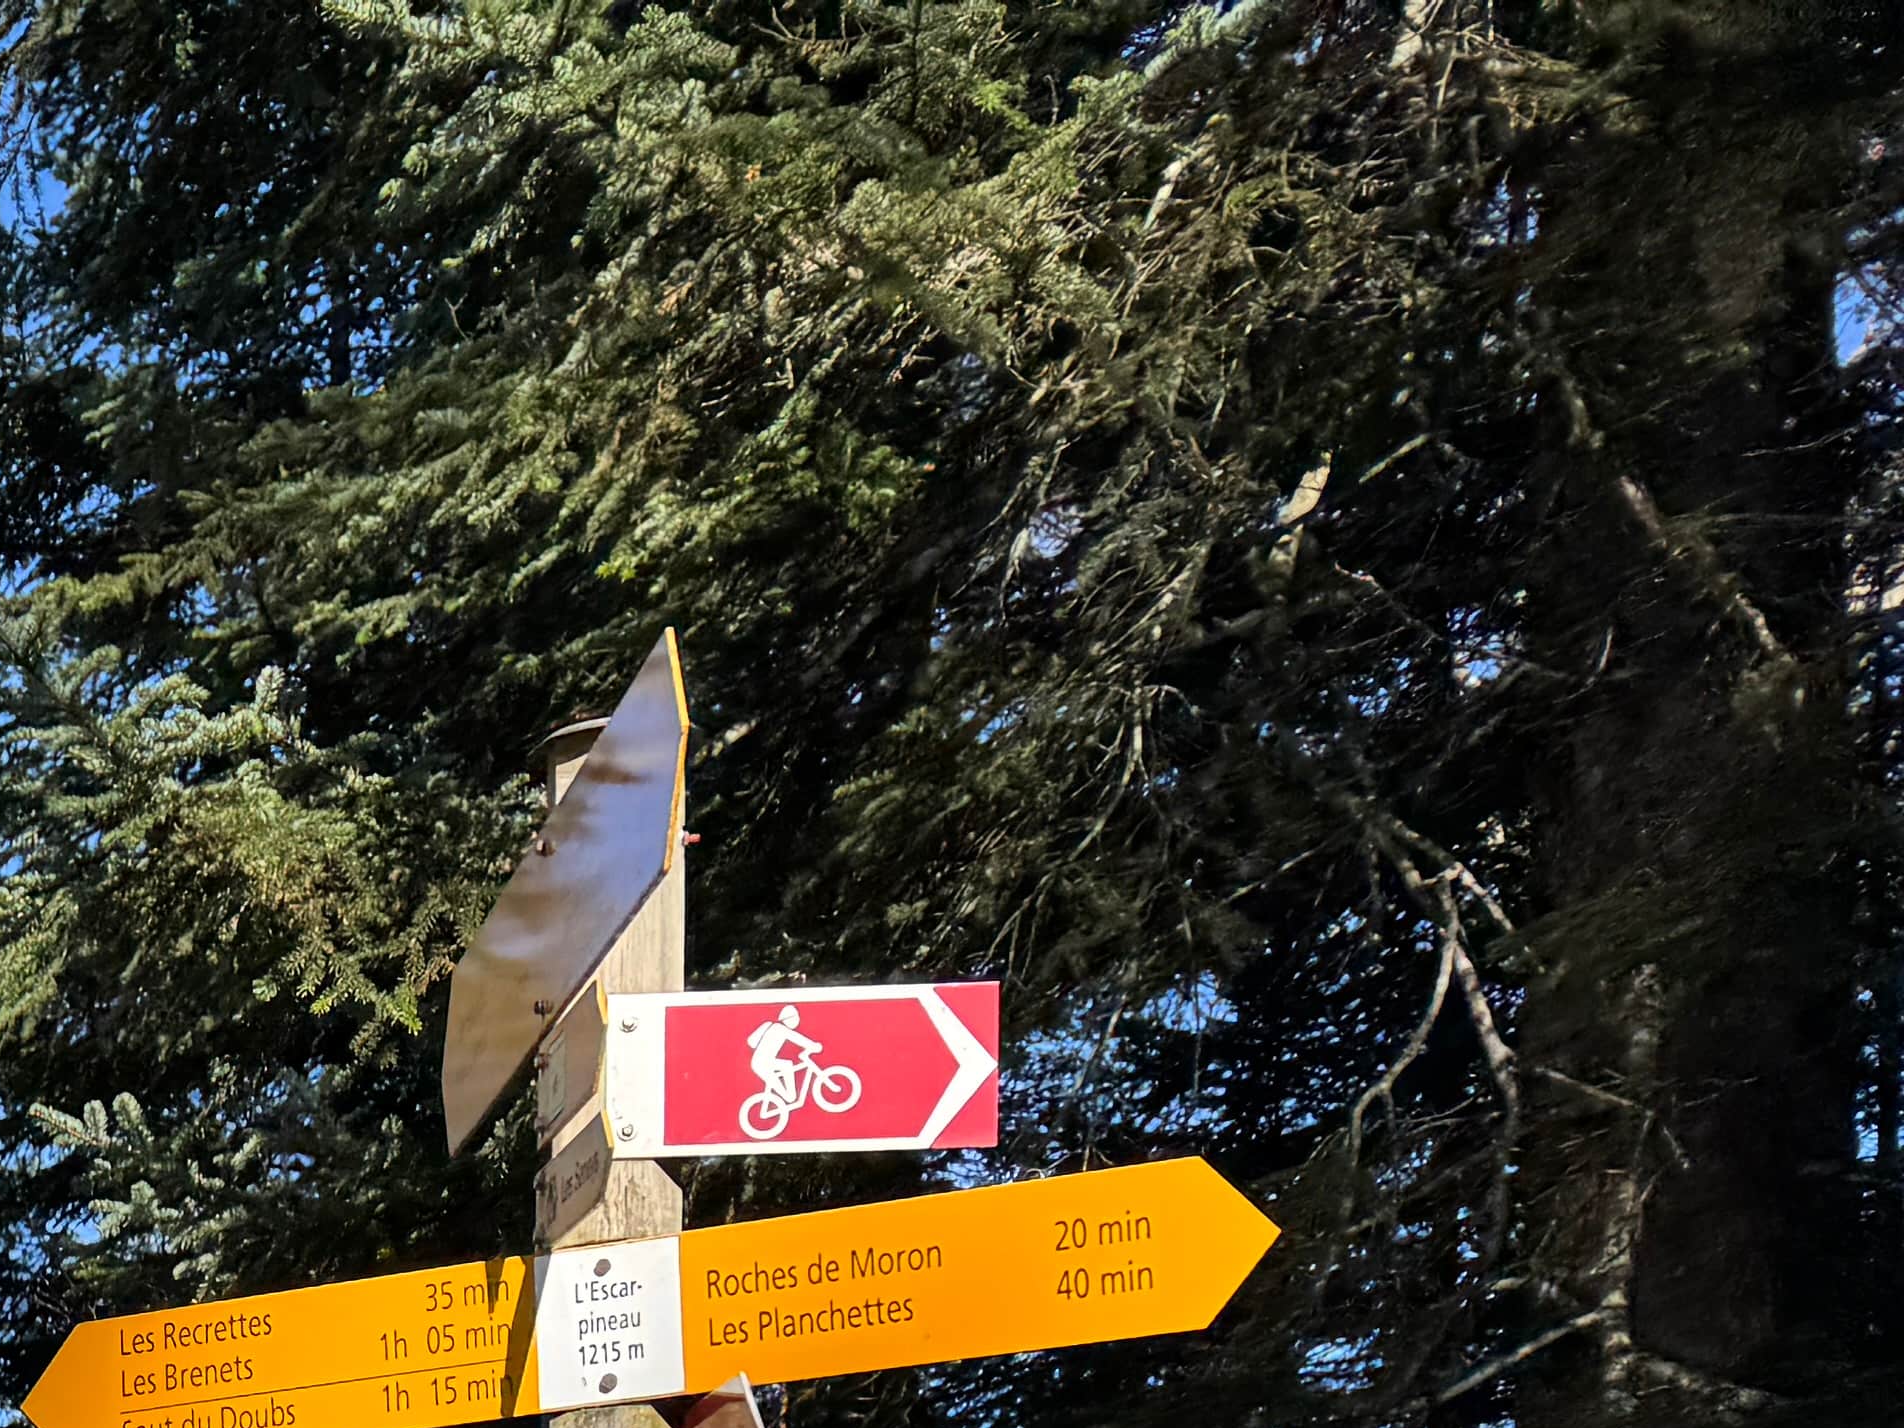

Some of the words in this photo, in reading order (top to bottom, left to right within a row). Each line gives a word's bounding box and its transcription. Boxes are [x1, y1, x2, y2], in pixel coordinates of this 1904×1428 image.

[706, 1263, 797, 1299] Roches
[808, 1253, 839, 1285] de
[851, 1244, 942, 1278] Moron
[1055, 1218, 1086, 1251] 20
[1098, 1210, 1151, 1246] min
[120, 1329, 155, 1356] Les
[164, 1312, 272, 1349] Recrettes
[425, 1281, 453, 1312] 35
[575, 1280, 642, 1303] L'Escar-
[709, 1316, 747, 1347] Les
[759, 1296, 914, 1341] Planchettes
[1057, 1268, 1089, 1300] 40
[1101, 1260, 1153, 1296] min
[122, 1370, 156, 1397] Les
[165, 1357, 254, 1393] Brenets
[380, 1330, 407, 1360] 1h
[427, 1324, 455, 1352] 05
[466, 1313, 511, 1349] min
[579, 1311, 640, 1340] pineau
[579, 1341, 620, 1367] 1215
[629, 1343, 644, 1360] m
[383, 1385, 409, 1412] 1h
[431, 1377, 457, 1405] 15
[468, 1369, 513, 1401] min
